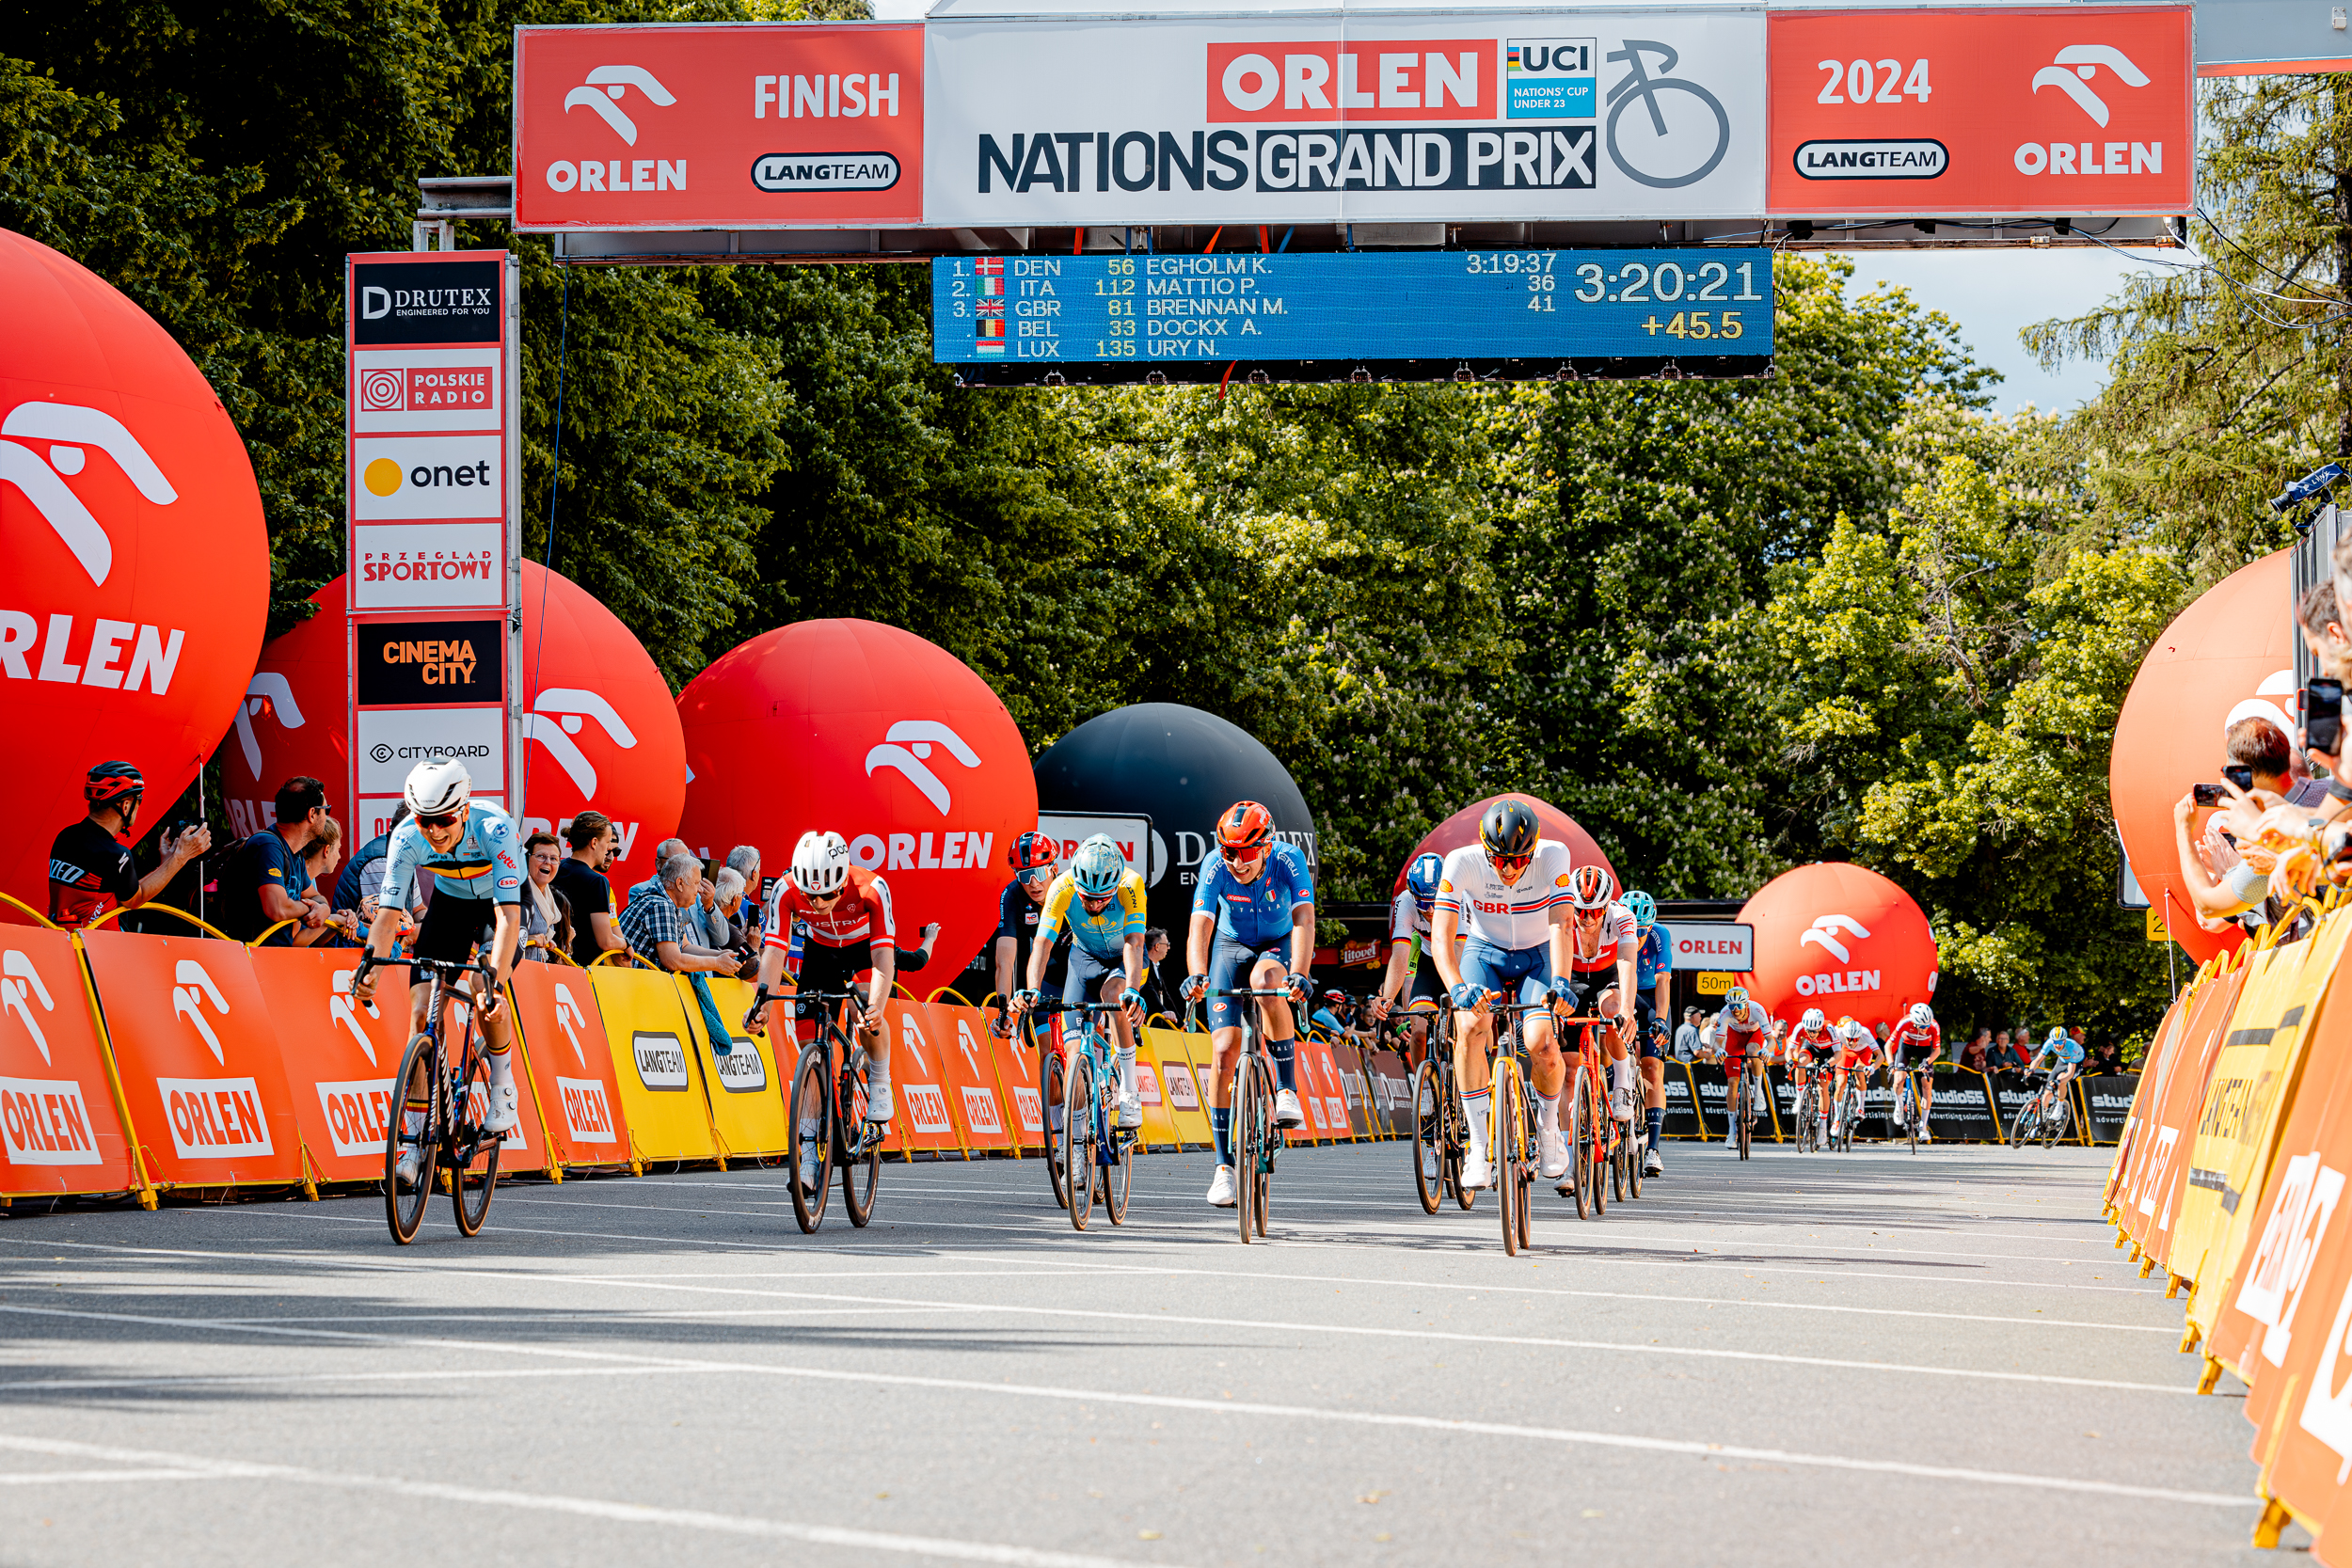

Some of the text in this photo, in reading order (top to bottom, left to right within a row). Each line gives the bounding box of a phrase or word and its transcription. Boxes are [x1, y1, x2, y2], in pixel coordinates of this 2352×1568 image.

[1522, 45, 1588, 71] UCI
[1221, 52, 1478, 111] ORLEN
[1817, 58, 1931, 104] 2024
[755, 72, 899, 119] FINISH
[1513, 87, 1589, 98] NATIONS' CUP
[1513, 99, 1565, 109] UNDER 23
[978, 130, 1592, 193] NATIONS GRAND PRIX
[1806, 150, 1937, 168] LANGTEAM
[2014, 141, 2162, 176] ORLEN
[546, 159, 687, 192] ORLEN
[764, 163, 889, 181] LANGTEAM
[953, 258, 1272, 277] 1. DEN 56 EGHOLM K.
[1466, 252, 1557, 274] 3:19:37
[952, 278, 1260, 297] 2. ITA 112 MATTIO P.
[1528, 275, 1555, 292] 36
[1574, 261, 1762, 303] 3:20:21
[394, 289, 491, 308] DRUTEX
[952, 298, 1288, 317] 3. GBR 81 BRENNAN M.
[1527, 294, 1556, 312] 41
[1019, 319, 1262, 337] BEL 33 DOCKX A.
[1641, 311, 1743, 340] +45.5
[1017, 340, 1220, 357] LUX 135 URY N.
[415, 373, 485, 387] POLSKIE
[415, 390, 485, 404] RADIO
[410, 460, 490, 487] onet
[363, 561, 492, 581] SPORTOWY
[0, 610, 185, 696] RLEN
[383, 640, 477, 664] CINEMA
[422, 661, 477, 685] CITY
[398, 745, 490, 759] CITYBOARD
[849, 832, 993, 871] ORLEN
[1232, 903, 1281, 913] ITALIA
[1472, 899, 1510, 914] GBR
[808, 915, 867, 927] USTRIA
[1343, 944, 1376, 964] Litovel
[1678, 940, 1742, 955] ORLEN
[1701, 976, 1731, 990] 50m
[1795, 969, 1881, 997] ORLEN
[431, 990, 441, 1023] CANYON
[637, 1048, 685, 1075] LANGTEAM
[716, 1053, 762, 1076] LANGTEAM
[169, 1089, 264, 1148] ORLEN
[564, 1085, 611, 1133] ORLEN
[908, 1091, 946, 1126] ORLEN
[968, 1092, 998, 1127] ORLEN
[1, 1088, 91, 1152] ORLEN
